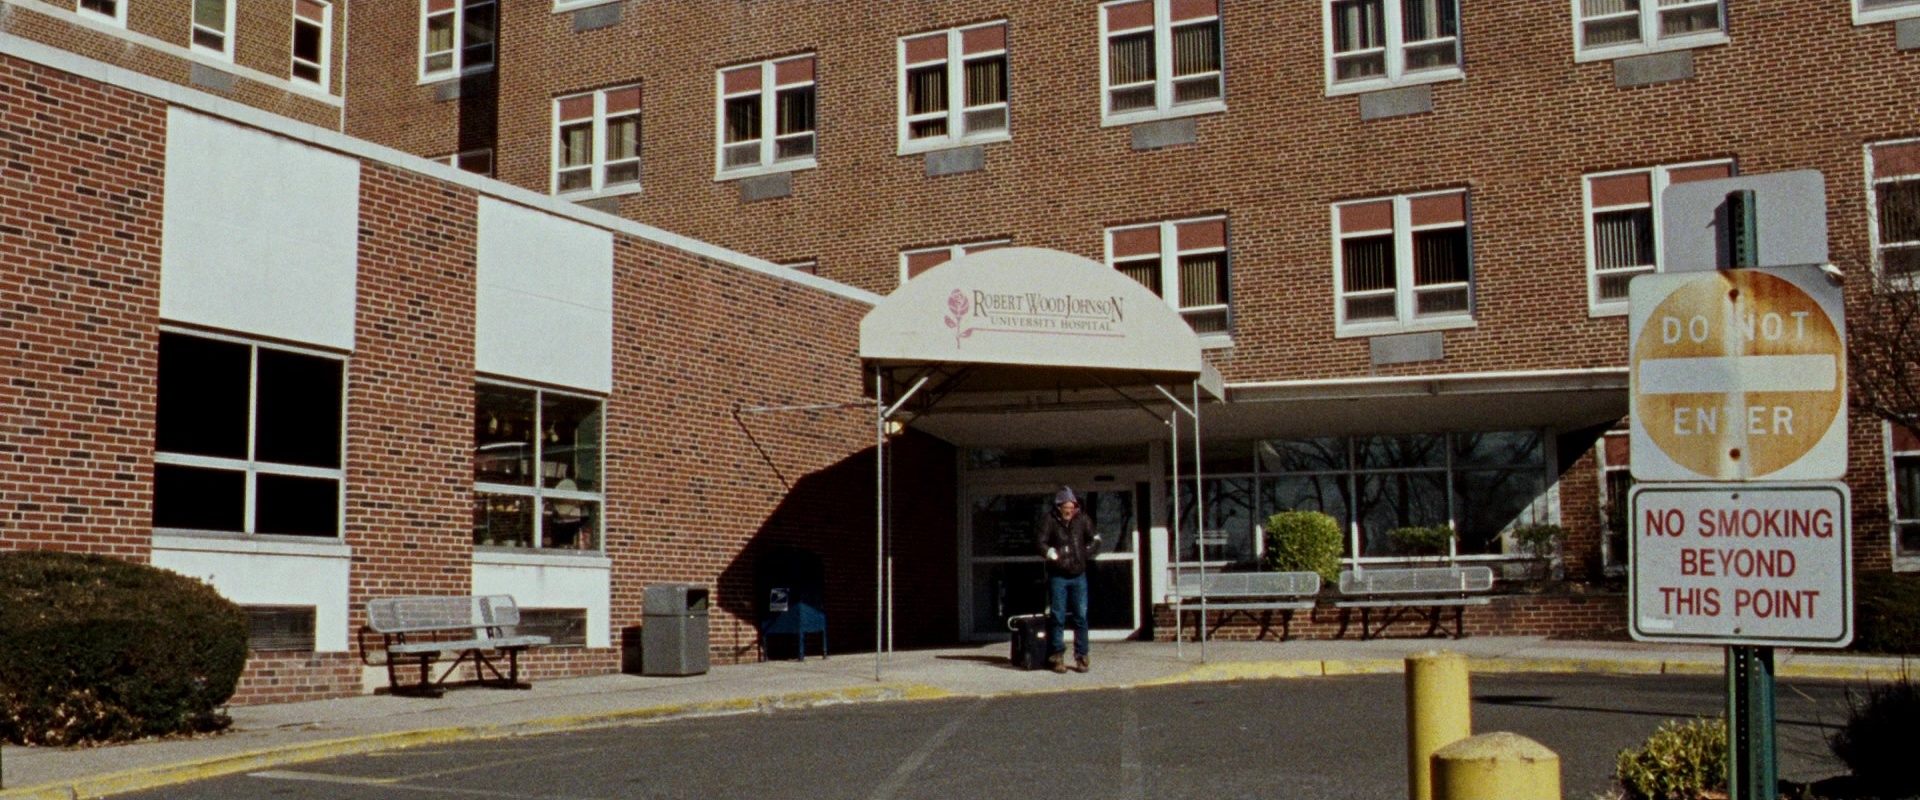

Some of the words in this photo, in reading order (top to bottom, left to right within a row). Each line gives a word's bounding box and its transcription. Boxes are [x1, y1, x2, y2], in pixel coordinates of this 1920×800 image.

[973, 289, 1024, 317] ROBERT
[1025, 293, 1065, 315] WOOD
[1065, 295, 1124, 323] JOHNSON
[991, 317, 1057, 329] UNIVERSITY
[1061, 321, 1112, 332] HOSPITAL
[1662, 315, 1710, 344] DO
[1735, 311, 1810, 341] NOT
[1645, 508, 1685, 537] NO
[1698, 508, 1833, 539] SMOKING
[1680, 548, 1796, 578] BEYOND
[1659, 587, 1721, 617] THIS
[1735, 588, 1820, 619] POINT
